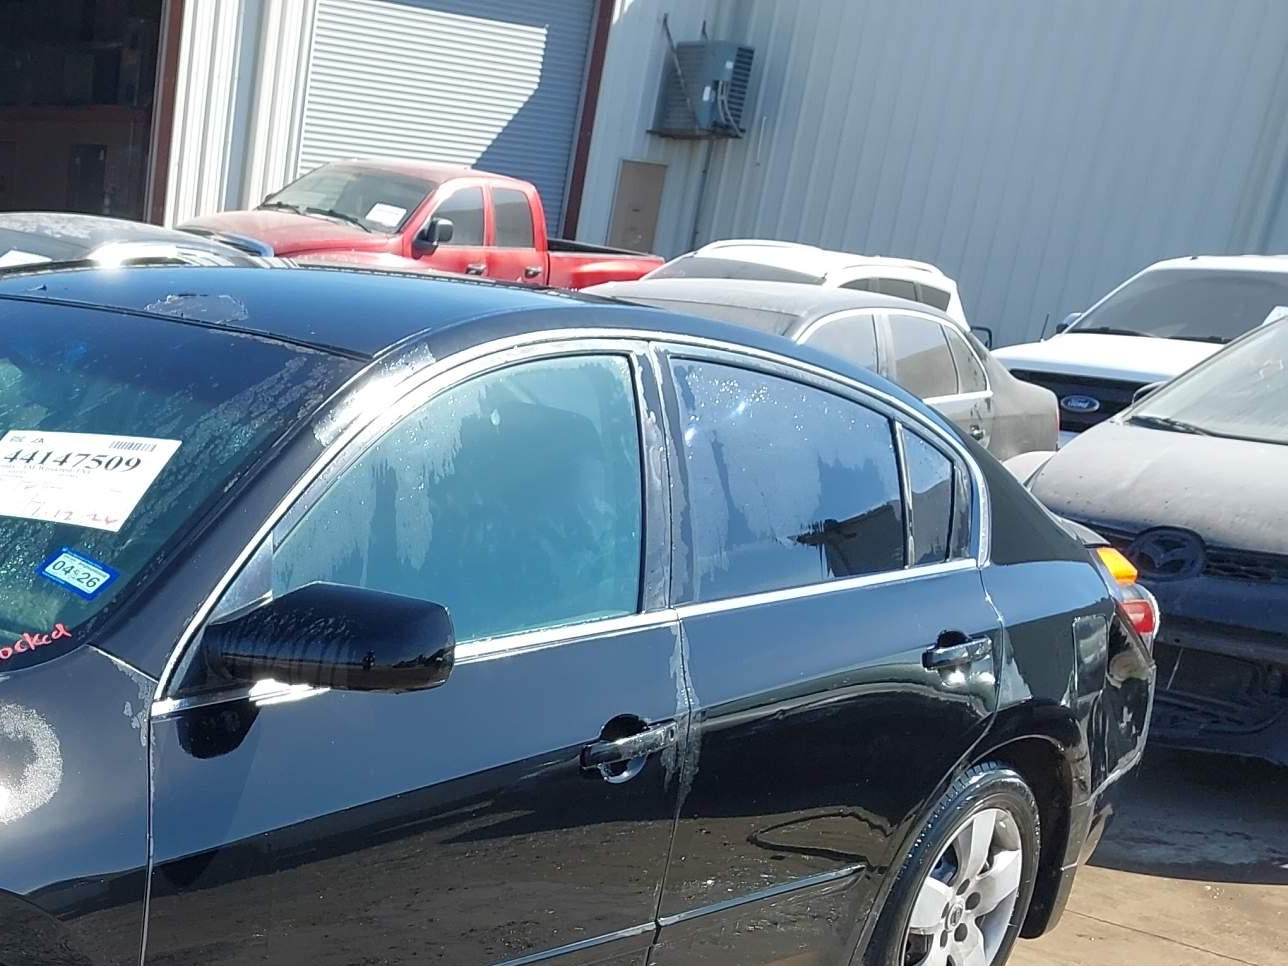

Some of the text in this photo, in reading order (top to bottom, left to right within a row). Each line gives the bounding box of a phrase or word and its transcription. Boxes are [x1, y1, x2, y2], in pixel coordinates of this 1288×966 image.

[3, 449, 142, 473] 44147509
[52, 560, 74, 576] 04
[76, 571, 101, 588] 26
